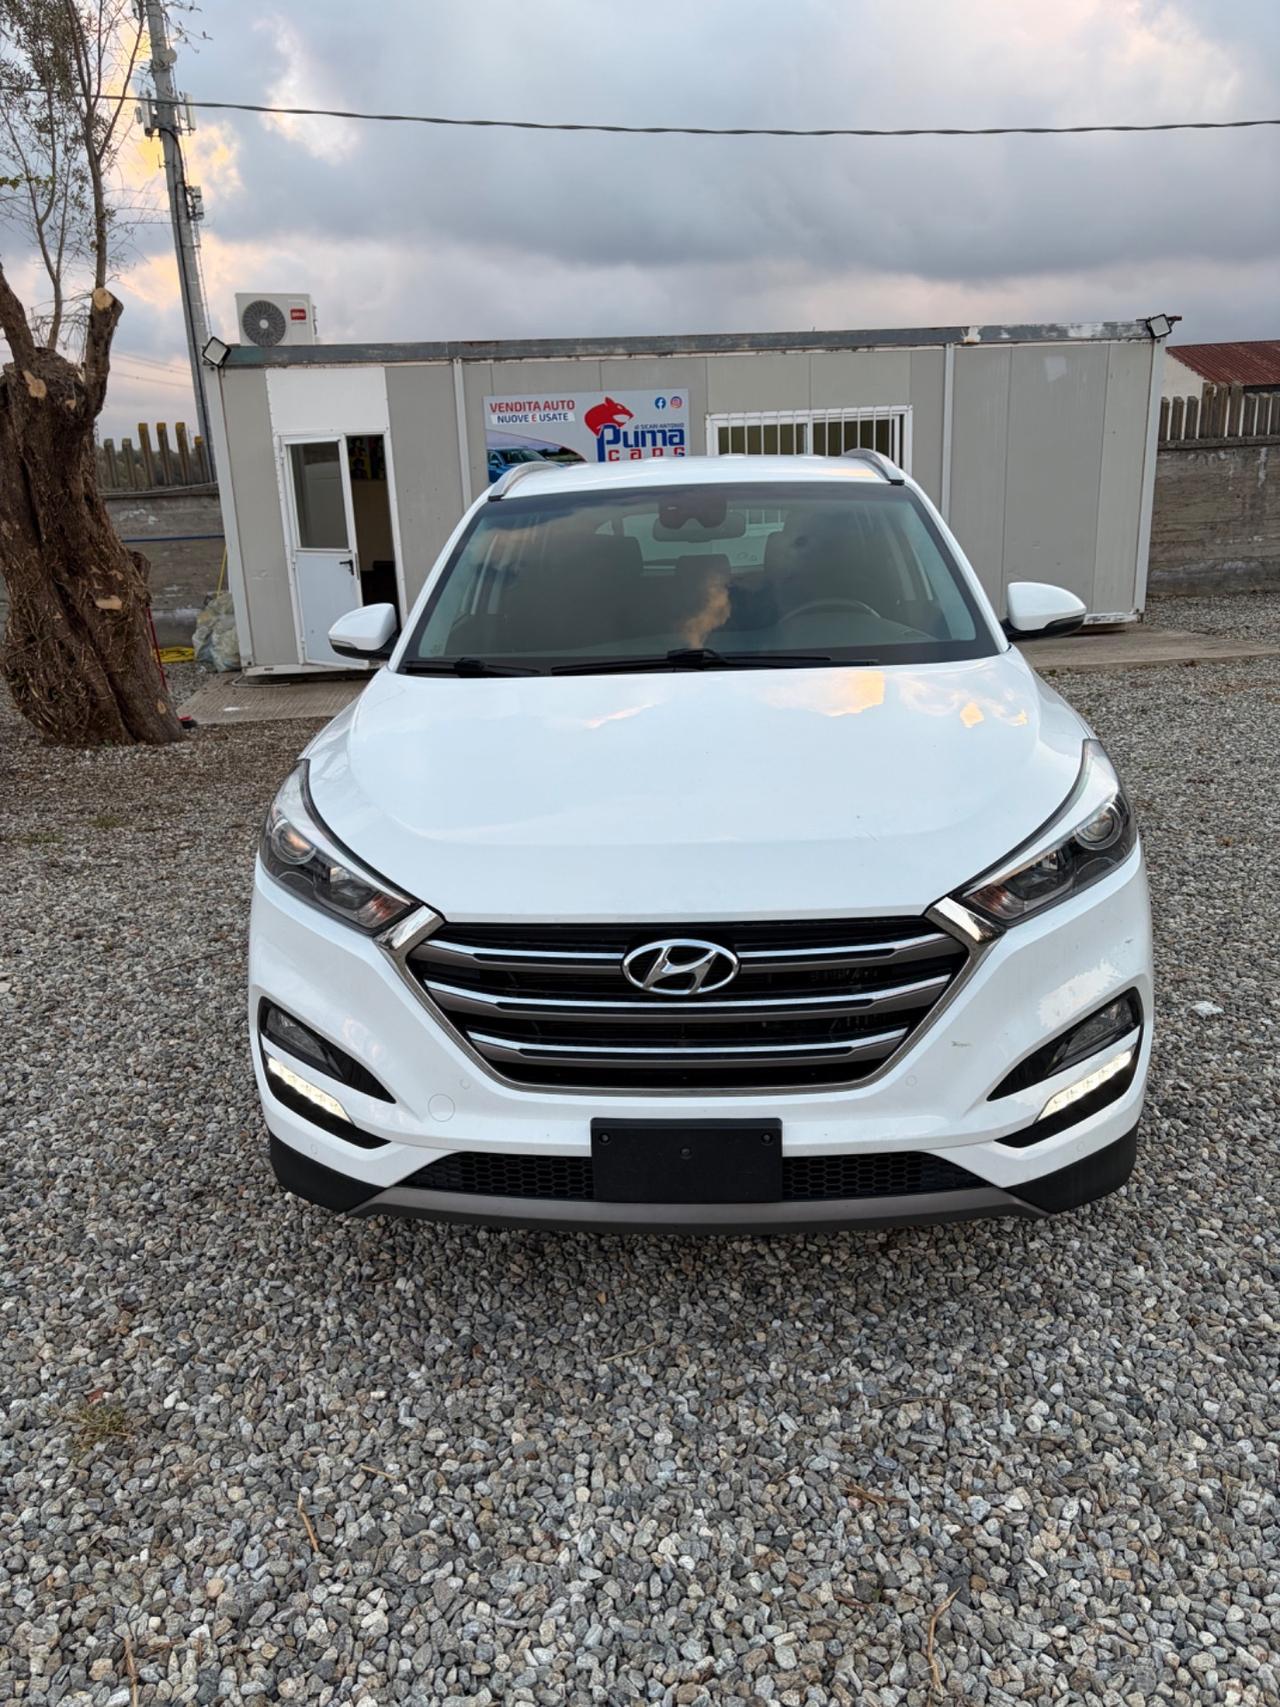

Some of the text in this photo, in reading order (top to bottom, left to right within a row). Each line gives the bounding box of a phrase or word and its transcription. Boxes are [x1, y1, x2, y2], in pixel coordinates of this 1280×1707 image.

[490, 399, 575, 413] VENDITA AUTO
[497, 412, 569, 424] NUOVE E USATE
[597, 424, 685, 462] Puma
